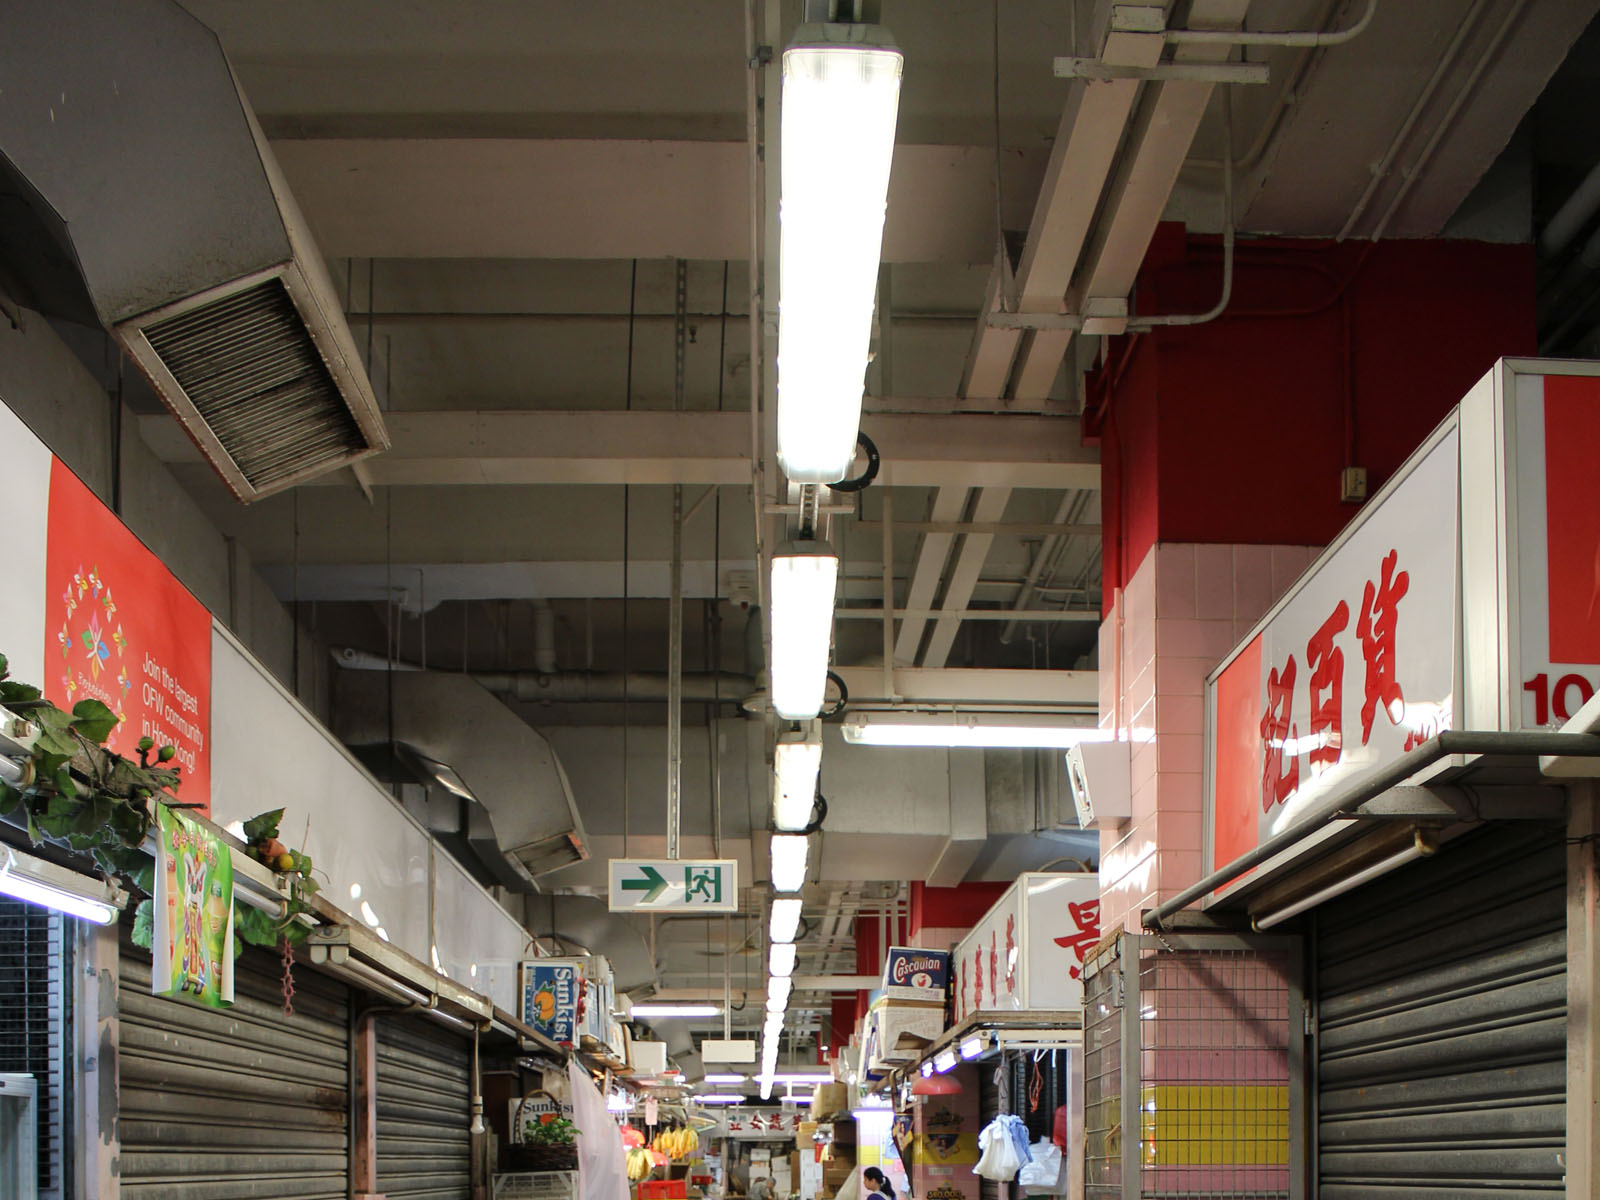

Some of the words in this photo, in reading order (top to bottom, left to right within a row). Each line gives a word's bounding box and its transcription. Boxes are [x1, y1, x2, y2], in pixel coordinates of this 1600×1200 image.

[142, 652, 161, 683] Join
[162, 667, 174, 694] the
[175, 677, 198, 715] largest
[142, 682, 165, 715] OFW
[165, 704, 204, 752] community
[142, 713, 151, 737] in
[174, 737, 195, 774] Kong!
[554, 968, 574, 1041] Sunkist
